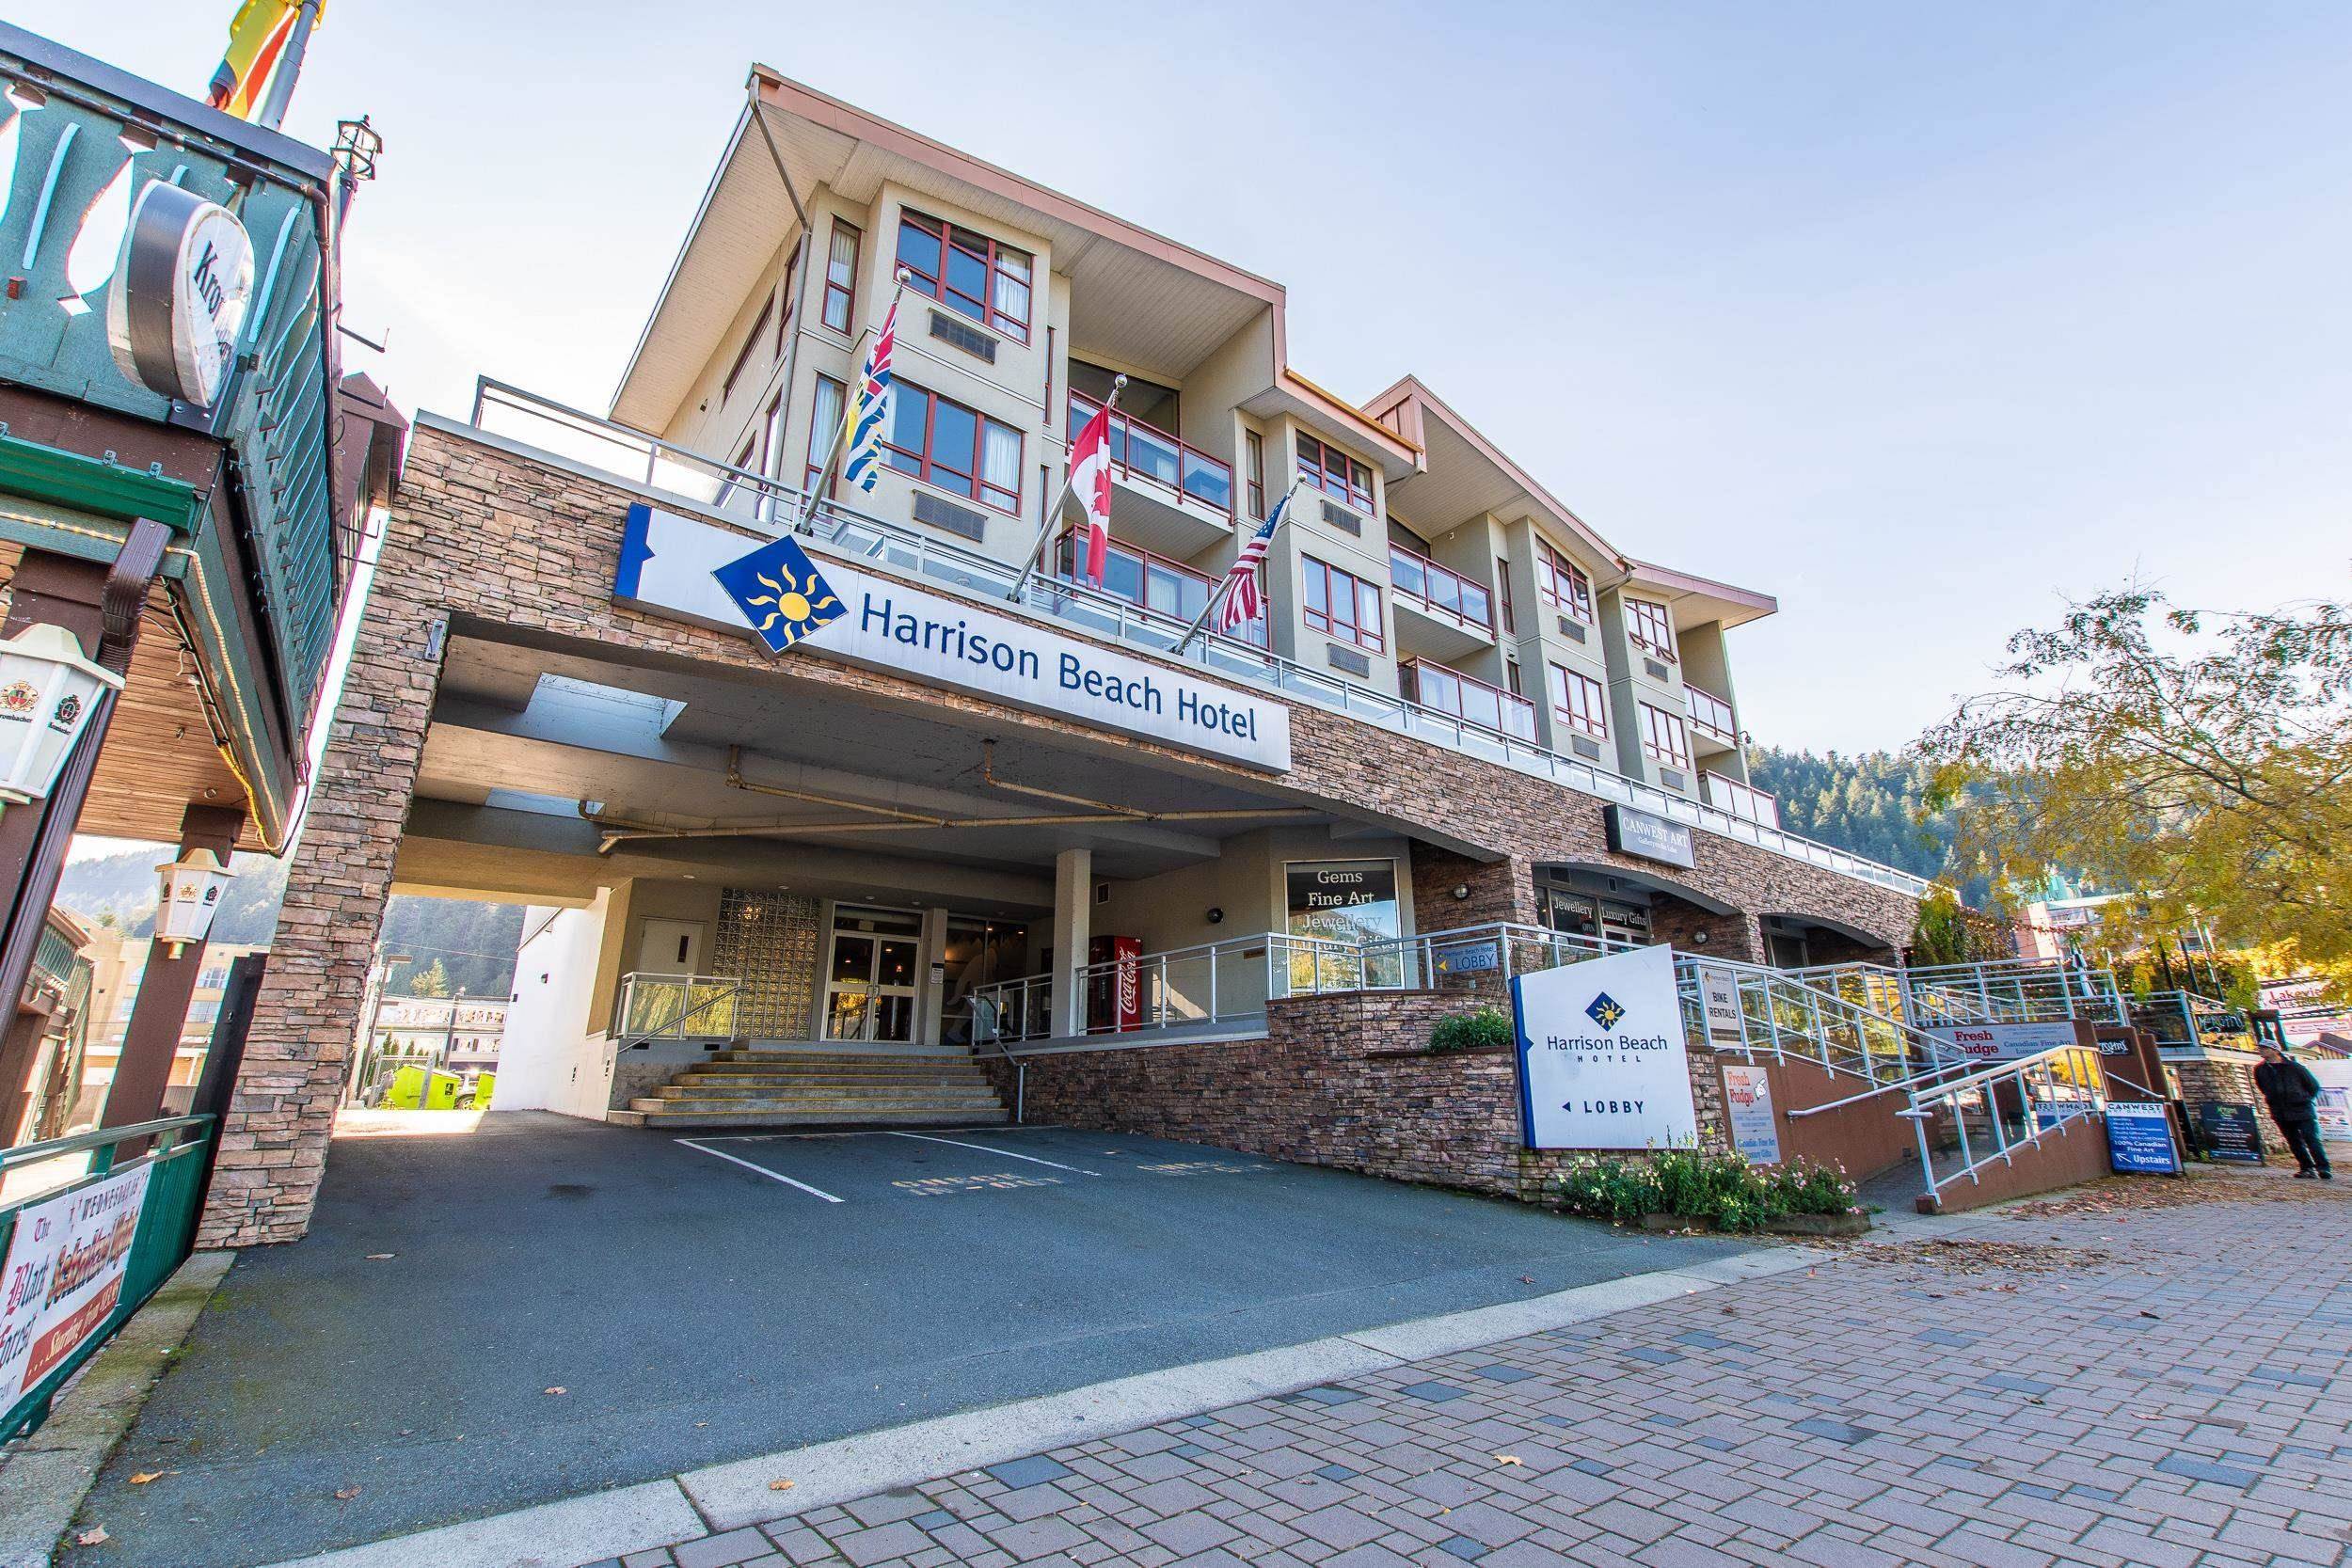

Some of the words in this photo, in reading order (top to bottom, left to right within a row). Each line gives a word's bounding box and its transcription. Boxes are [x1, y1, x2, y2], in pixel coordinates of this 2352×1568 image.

[861, 593, 1039, 680] Harrison
[1059, 652, 1162, 715] Beach
[1178, 688, 1257, 742] Hotel
[0, 714, 33, 723] rombacher
[1623, 816, 1667, 842] CANWEST
[1671, 832, 1689, 847] ART
[1317, 870, 1363, 883] Gems
[1308, 892, 1343, 906] Fine
[1347, 891, 1375, 905] Art
[1554, 896, 1593, 919] Jewellery
[1302, 913, 1382, 932] Jewellery
[1601, 906, 1629, 926] Luxury
[1629, 911, 1647, 927] Gifts
[1455, 953, 1494, 970] LOBBY
[1712, 991, 1728, 1003] BIKE
[1708, 1006, 1737, 1019] RENTALS
[1547, 1035, 1613, 1051] Harrison
[1619, 1035, 1668, 1051] Beach
[1954, 1031, 1994, 1041] Fresh
[1727, 1071, 1750, 1085] Fresh
[1729, 1088, 1755, 1107] Fudge
[1583, 1101, 1644, 1114] LOBBY
[2133, 1154, 2170, 1164] Upstairs
[34, 1217, 52, 1243] The
